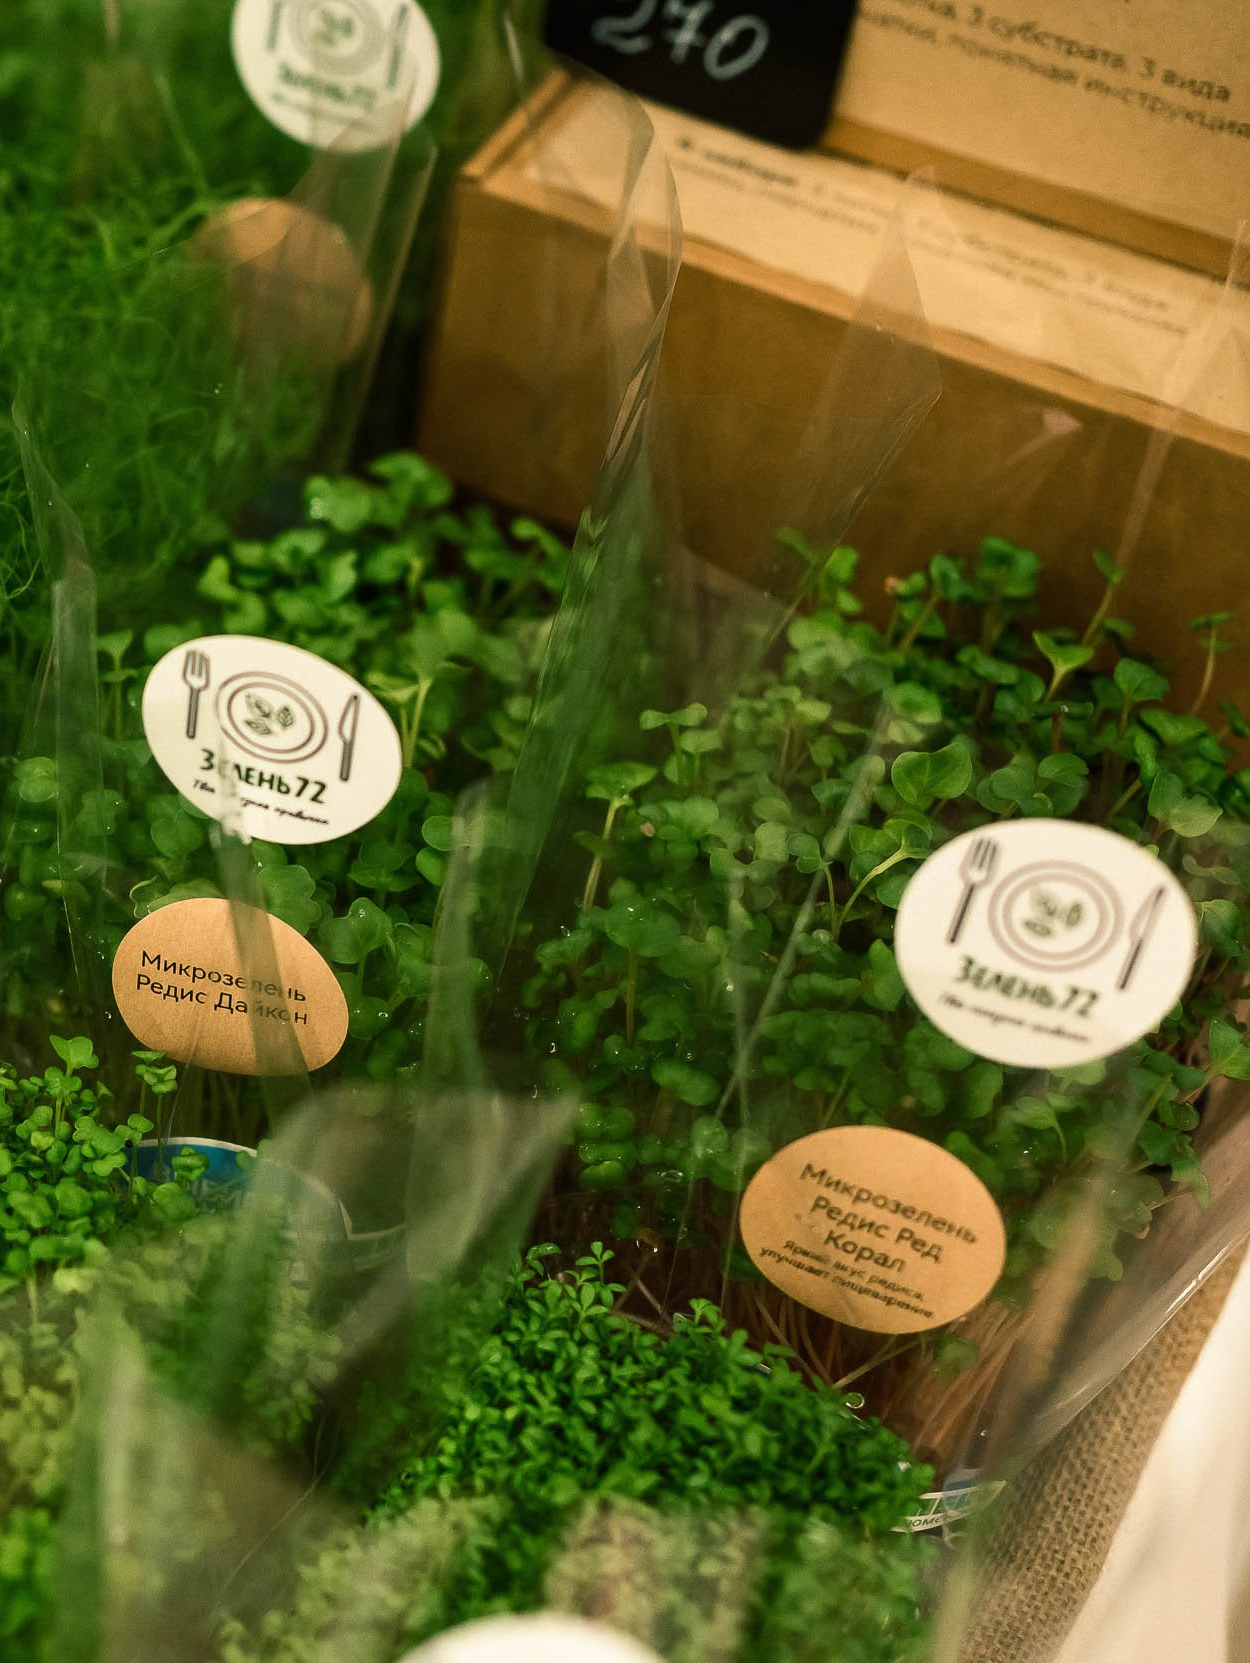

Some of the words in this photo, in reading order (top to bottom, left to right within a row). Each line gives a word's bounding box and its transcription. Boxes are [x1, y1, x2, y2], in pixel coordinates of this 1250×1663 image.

[199, 748, 328, 804] ЗЛЕНЬ72
[136, 973, 208, 1004] Редис
[213, 992, 308, 1025] Дайкон
[800, 1162, 978, 1245] Микрозелень
[810, 1195, 890, 1239] Редис
[895, 1227, 944, 1264] Ред
[824, 1229, 907, 1273] Корал
